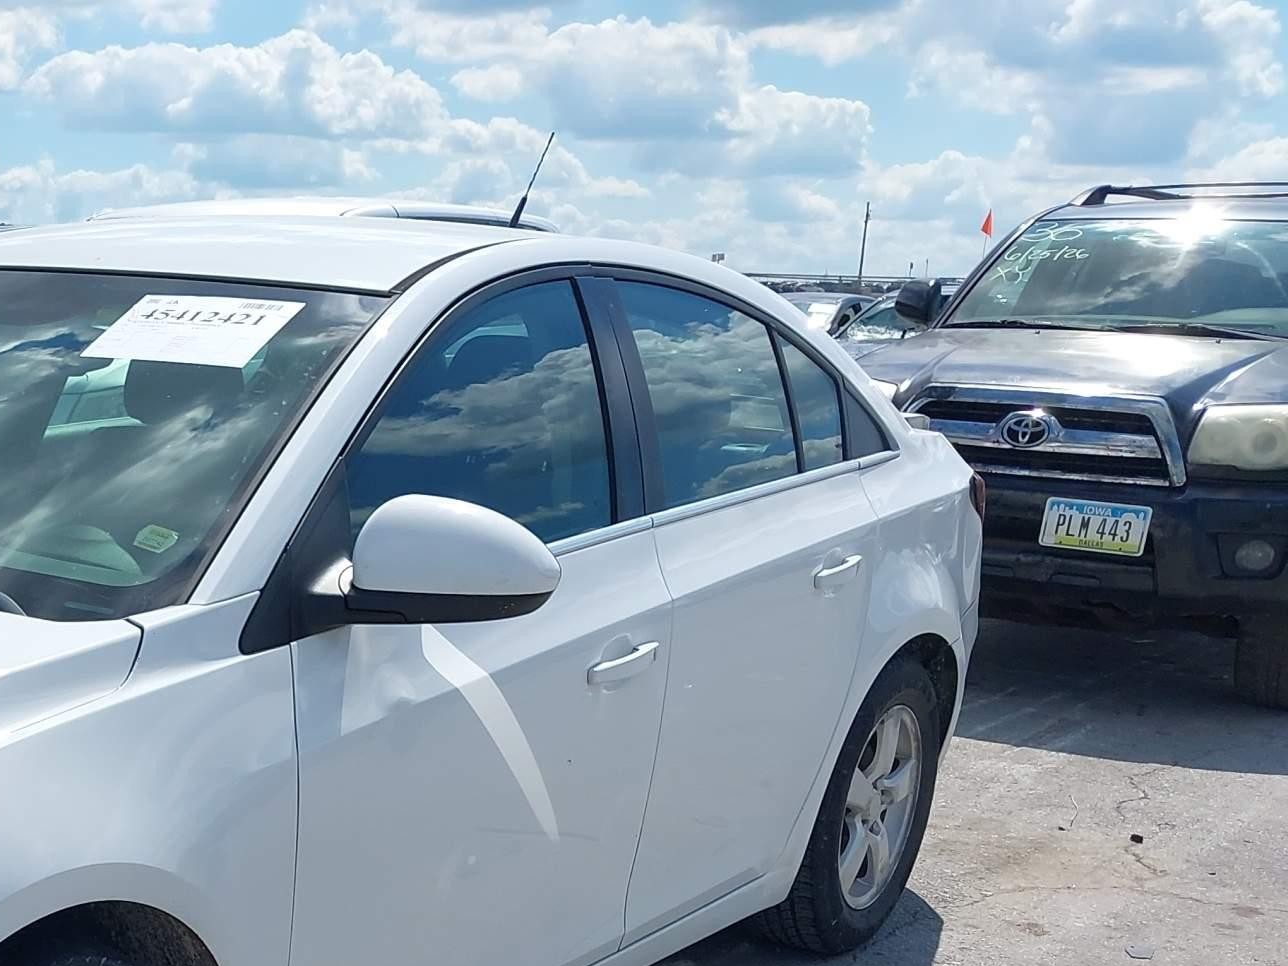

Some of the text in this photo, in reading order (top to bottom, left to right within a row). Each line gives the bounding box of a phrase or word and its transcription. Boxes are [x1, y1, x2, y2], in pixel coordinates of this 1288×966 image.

[1004, 245, 1090, 261] 6/25/26
[141, 308, 266, 325] 45412421
[1083, 504, 1112, 517] IOWA
[1054, 513, 1133, 543] PLM 443
[1078, 539, 1104, 548] DALLAS
